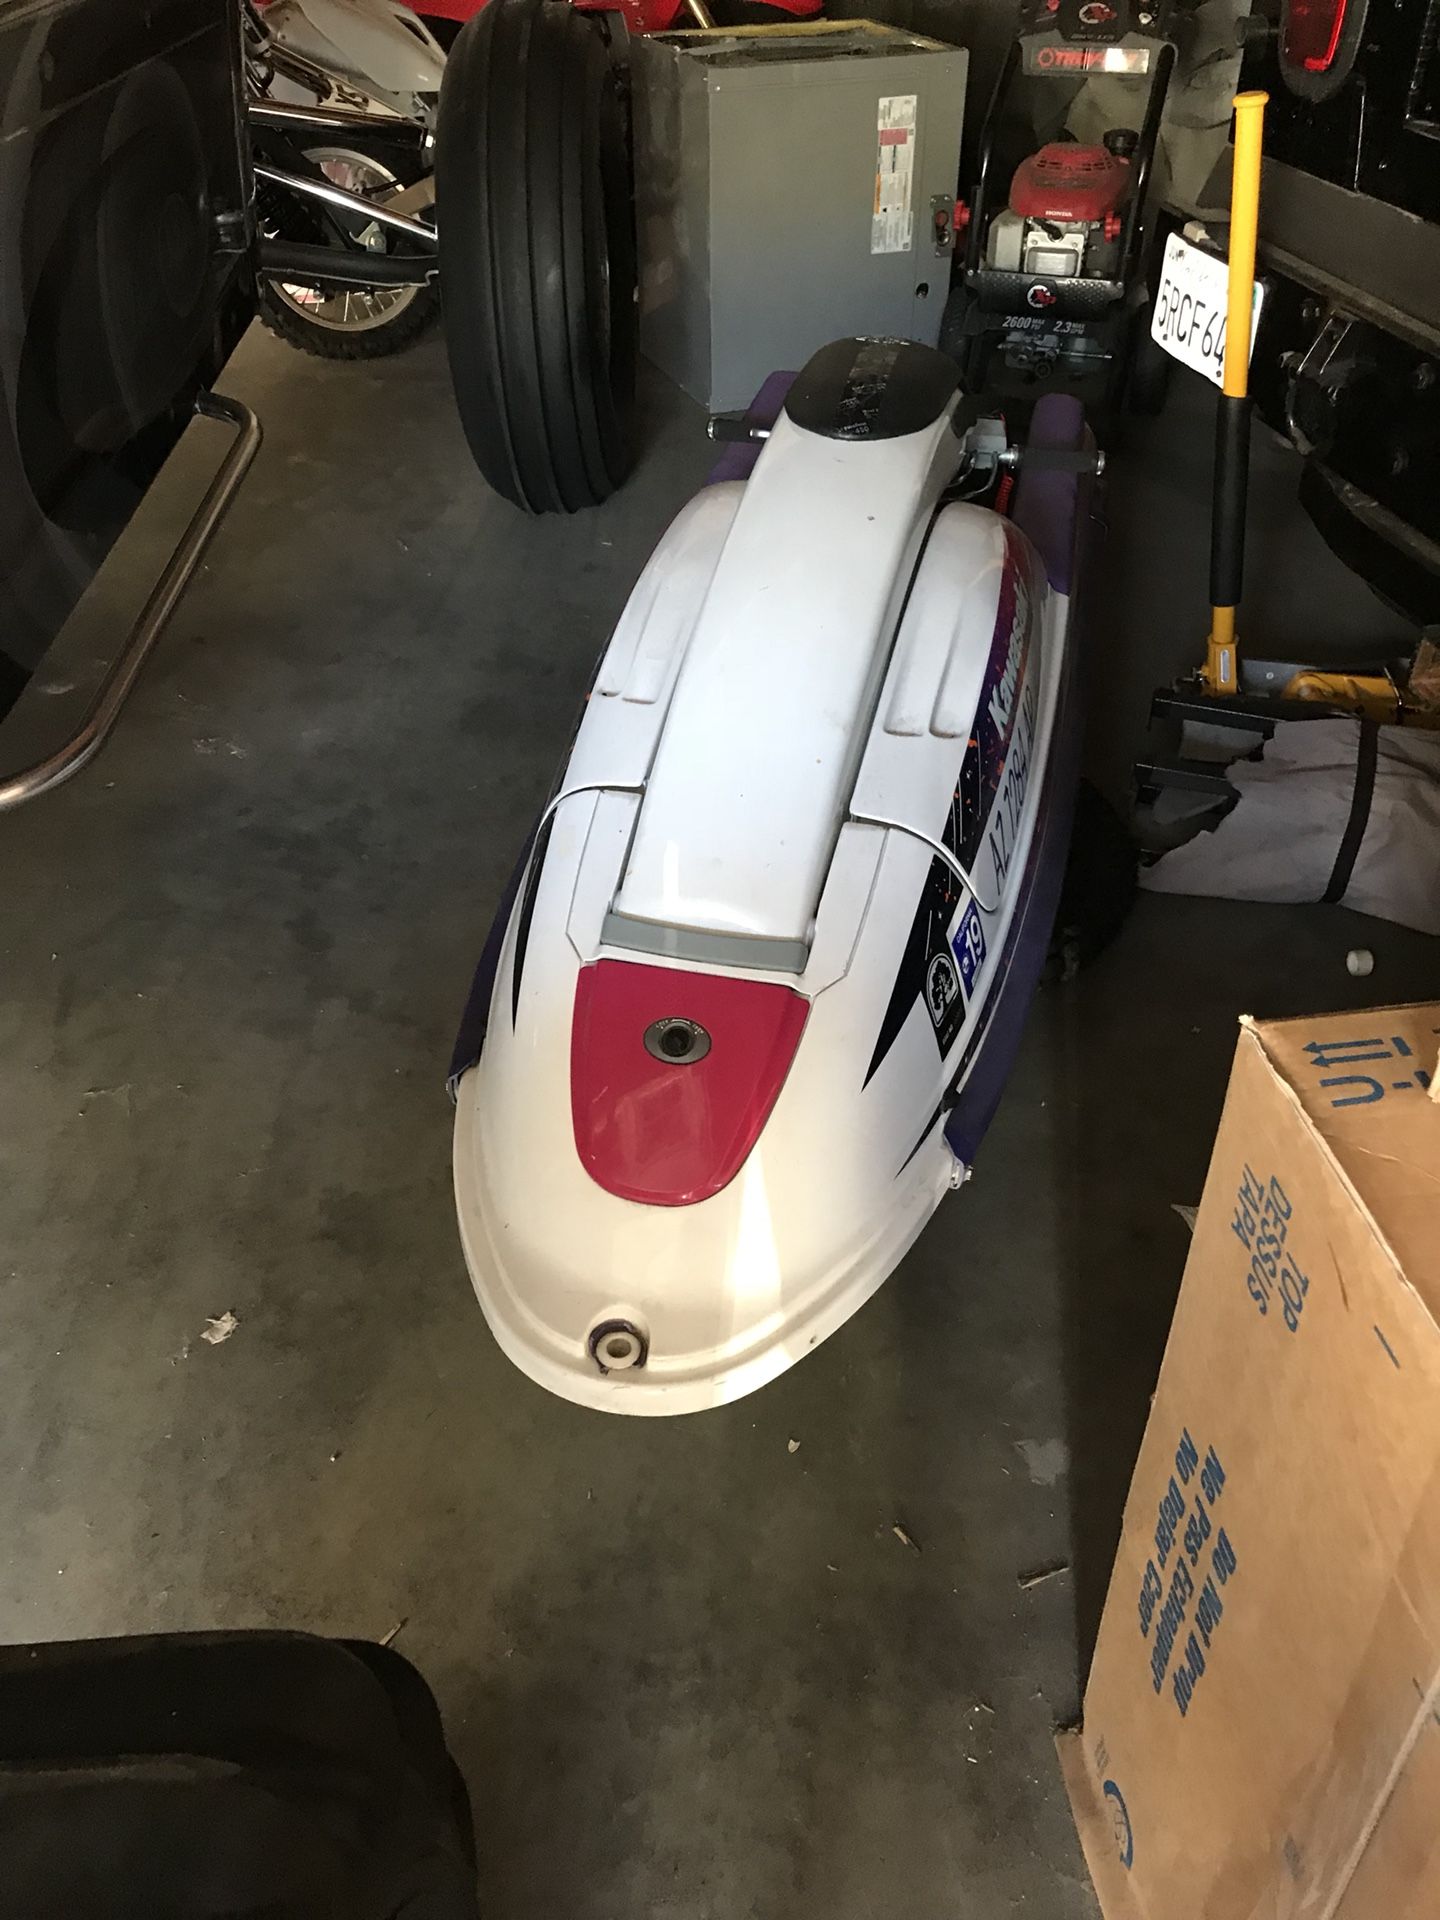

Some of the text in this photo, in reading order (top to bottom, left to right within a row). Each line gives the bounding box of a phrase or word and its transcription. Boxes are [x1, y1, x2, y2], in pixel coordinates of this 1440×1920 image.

[1045, 210, 1073, 218] HONDA
[1002, 316, 1032, 329] 2600
[1053, 320, 1072, 333] 2.3
[988, 810, 1011, 896] AZ
[965, 914, 983, 966] 19
[1231, 1163, 1264, 1251] TAPA
[1247, 1175, 1293, 1316] DESSUS
[1278, 1251, 1309, 1333] TOP
[1138, 1426, 1199, 1639] No Dejar Caer
[1150, 1443, 1226, 1695] Ne Pas Echapper
[1173, 1526, 1237, 1718] Do Not Drop
